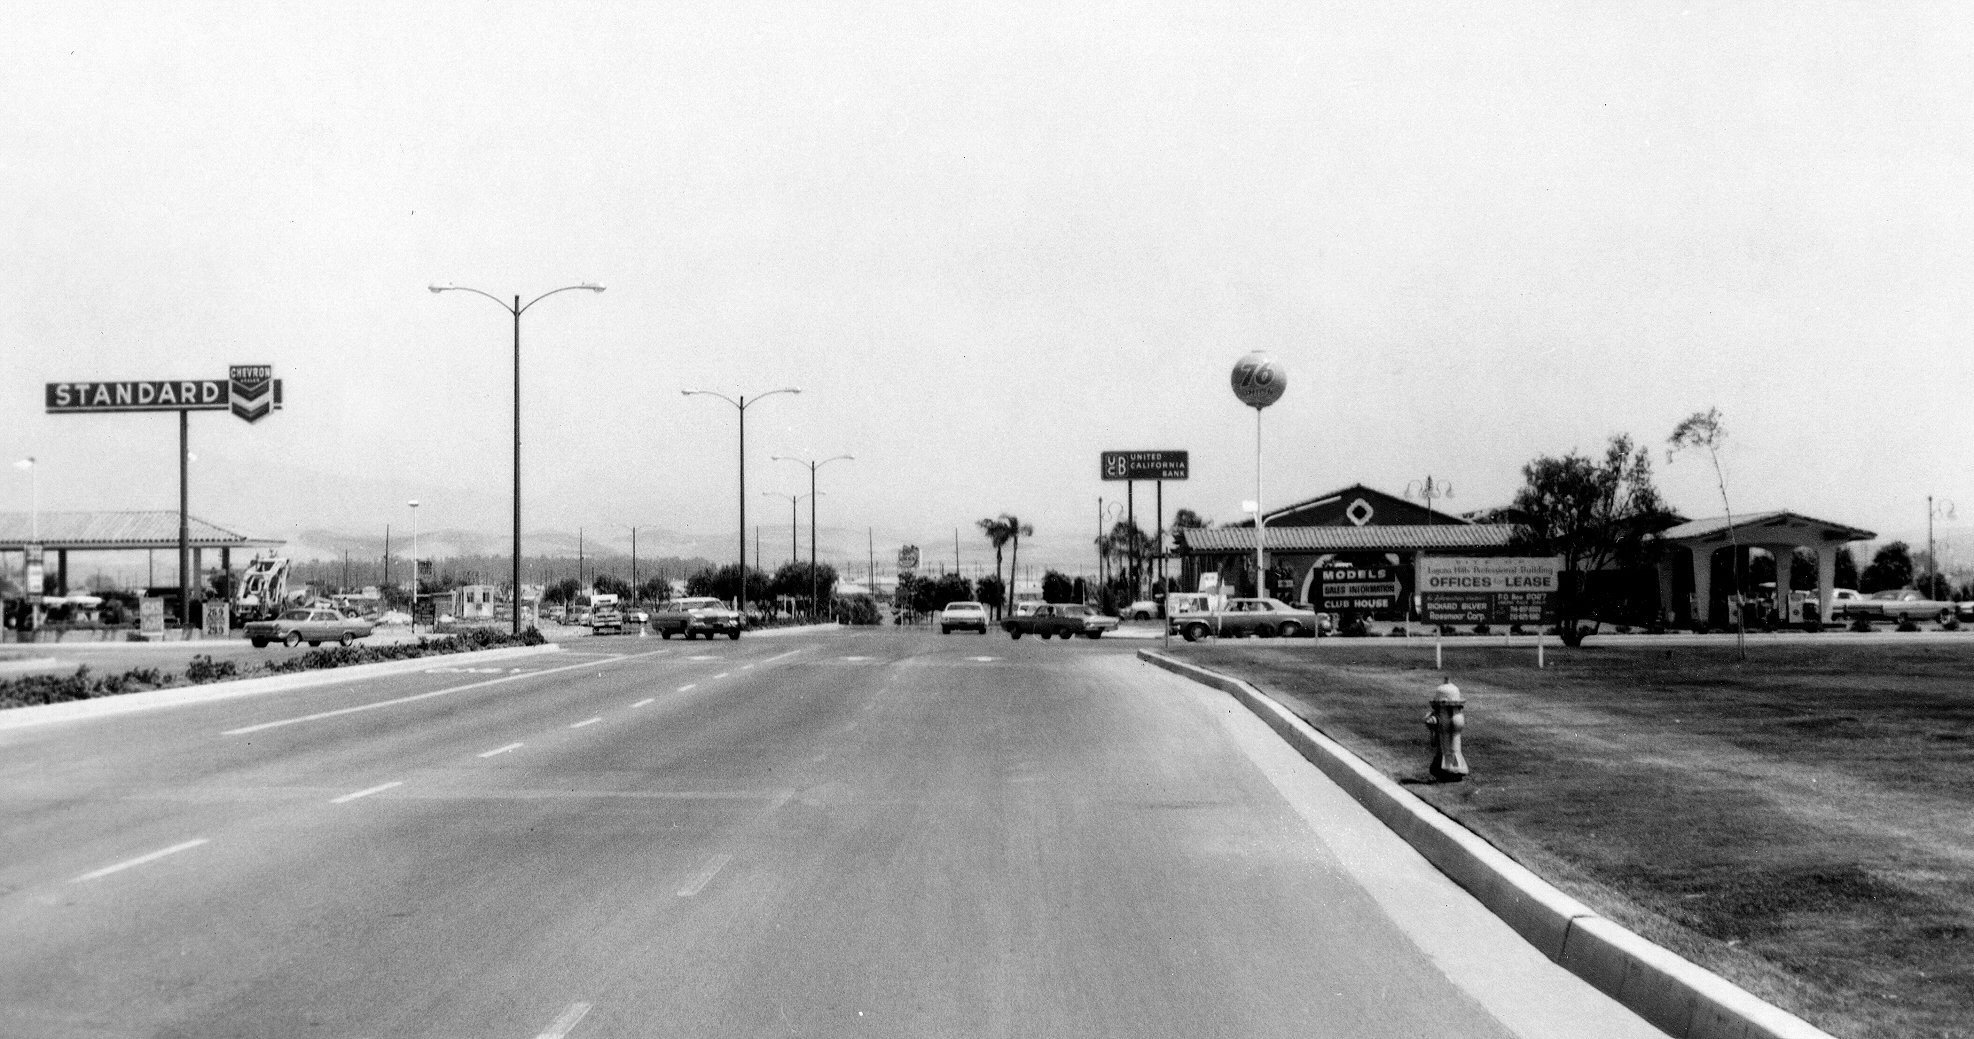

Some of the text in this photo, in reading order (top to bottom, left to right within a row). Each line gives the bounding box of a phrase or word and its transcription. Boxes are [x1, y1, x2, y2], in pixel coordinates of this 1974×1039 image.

[230, 367, 271, 378] CHEVRON
[1240, 363, 1275, 387] 76
[56, 381, 219, 406] STANDARD
[1130, 461, 1185, 469] CALIFORNIA
[1323, 569, 1386, 580] MODELS
[1473, 565, 1517, 574] Professional
[1520, 565, 1553, 576] Building
[1429, 576, 1491, 588] OFFICES
[1505, 576, 1551, 588] LEASE
[1324, 584, 1395, 594] SALES INFORMATION
[1324, 599, 1388, 608] CLUB HOUSE
[1427, 602, 1458, 610] RICHARD
[1429, 611, 1465, 620] Rossmoor
